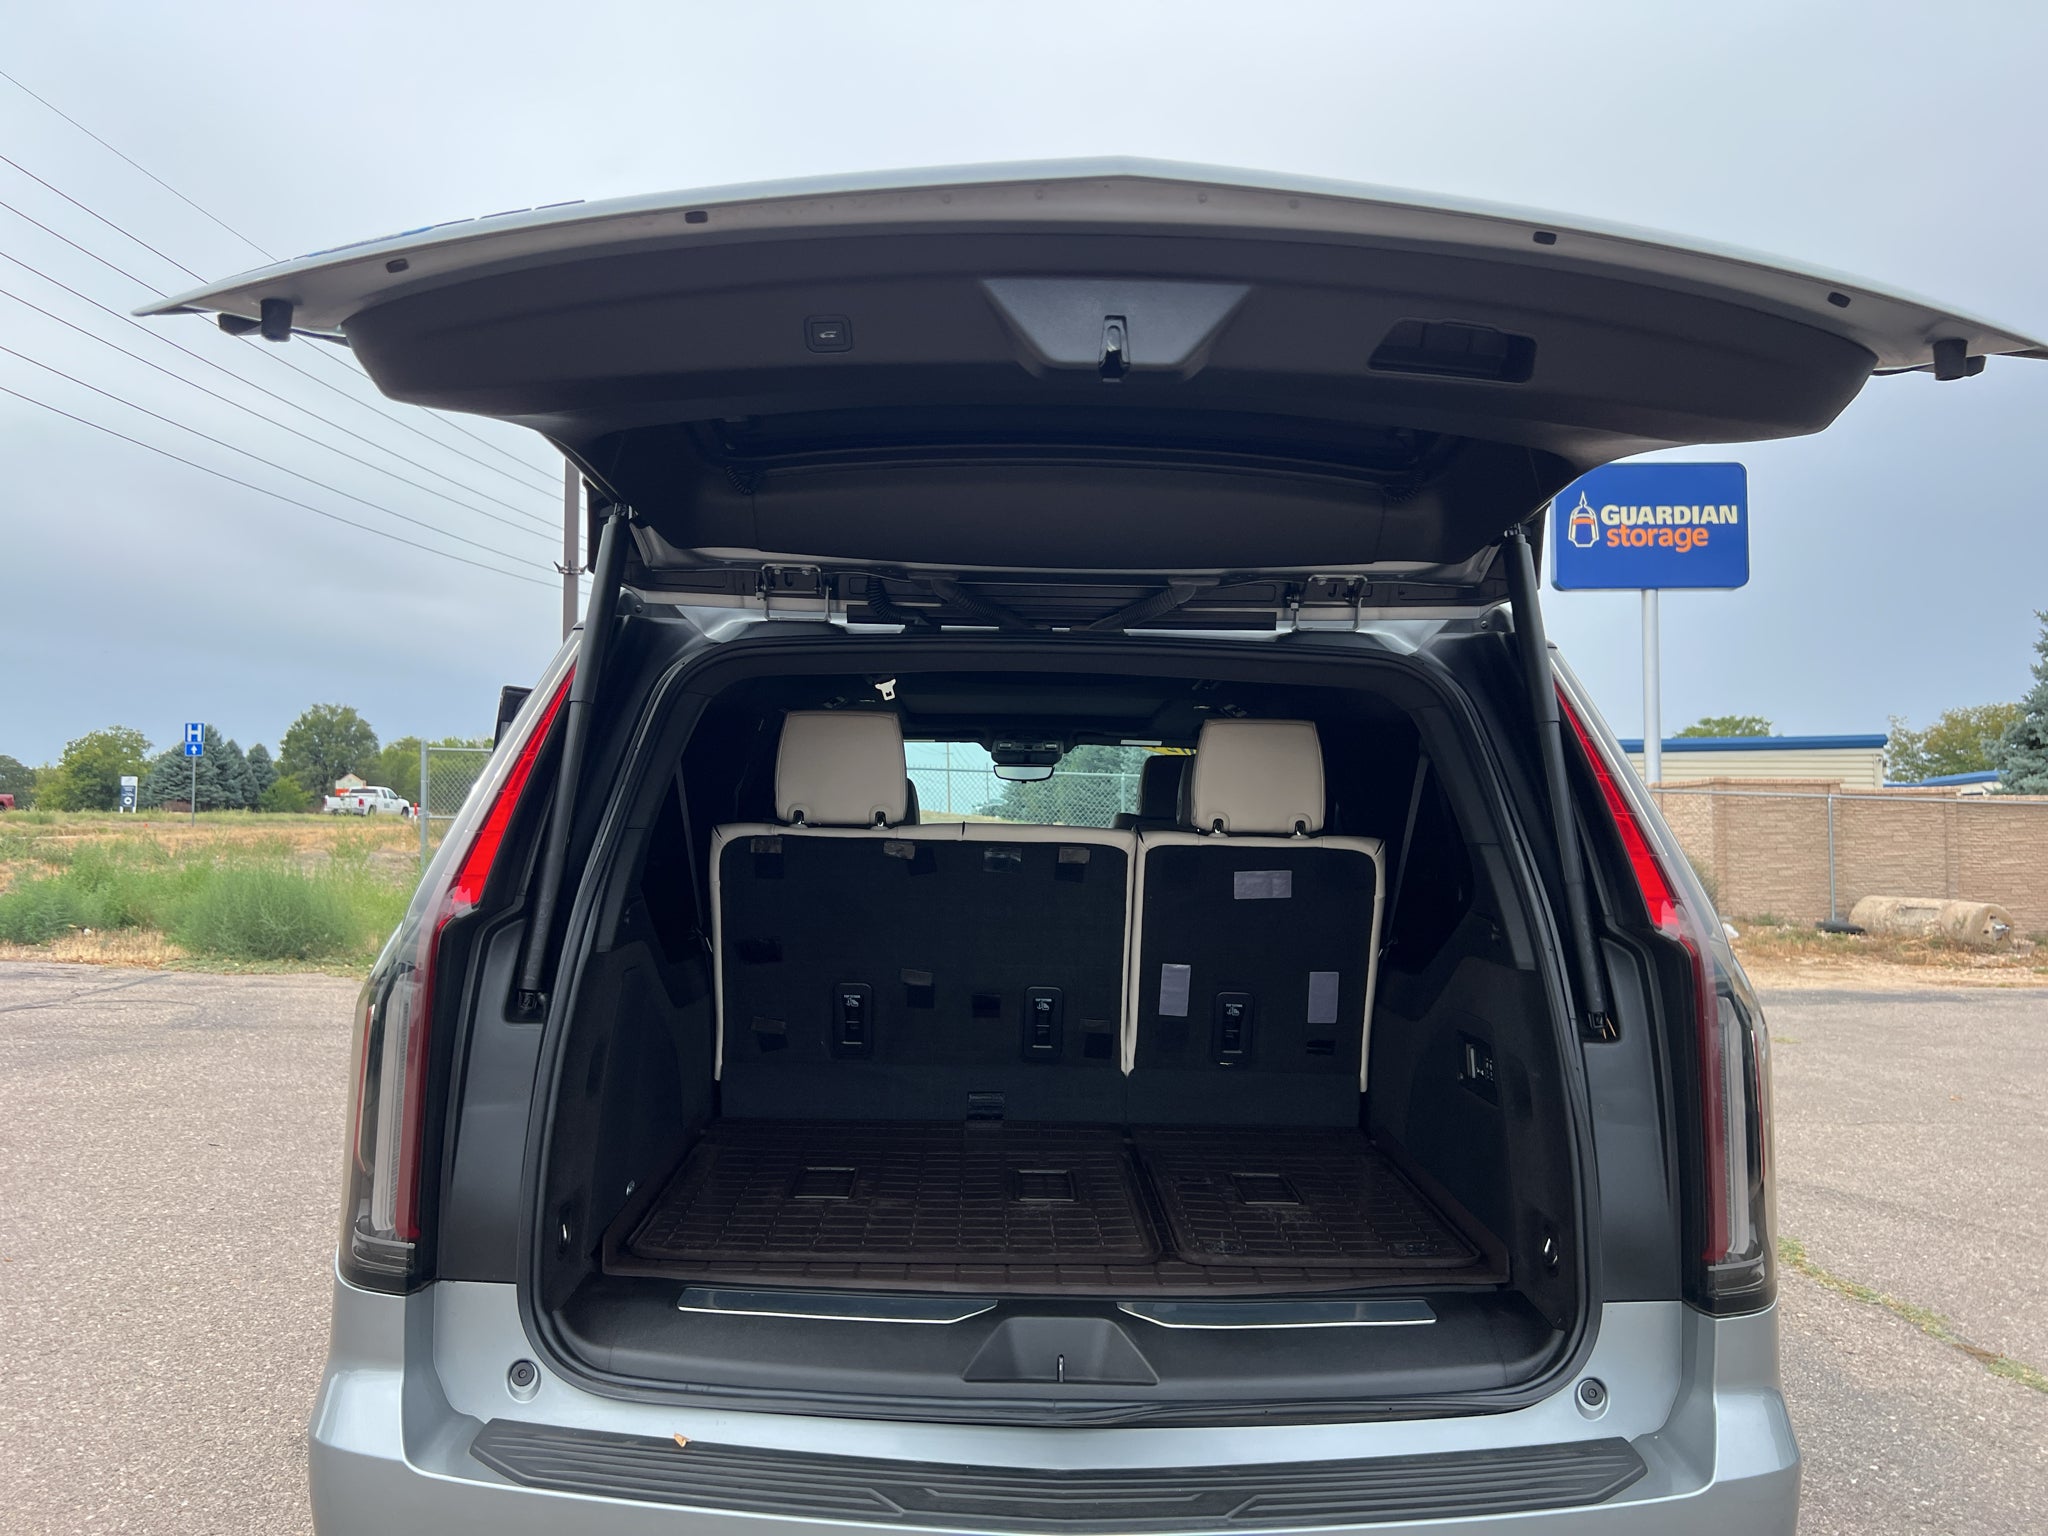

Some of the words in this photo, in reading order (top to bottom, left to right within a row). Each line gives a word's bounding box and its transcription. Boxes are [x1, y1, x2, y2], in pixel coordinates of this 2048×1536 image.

[1600, 504, 1738, 526] GUARDIAN
[1606, 524, 1710, 553] storage
[187, 723, 203, 742] H
